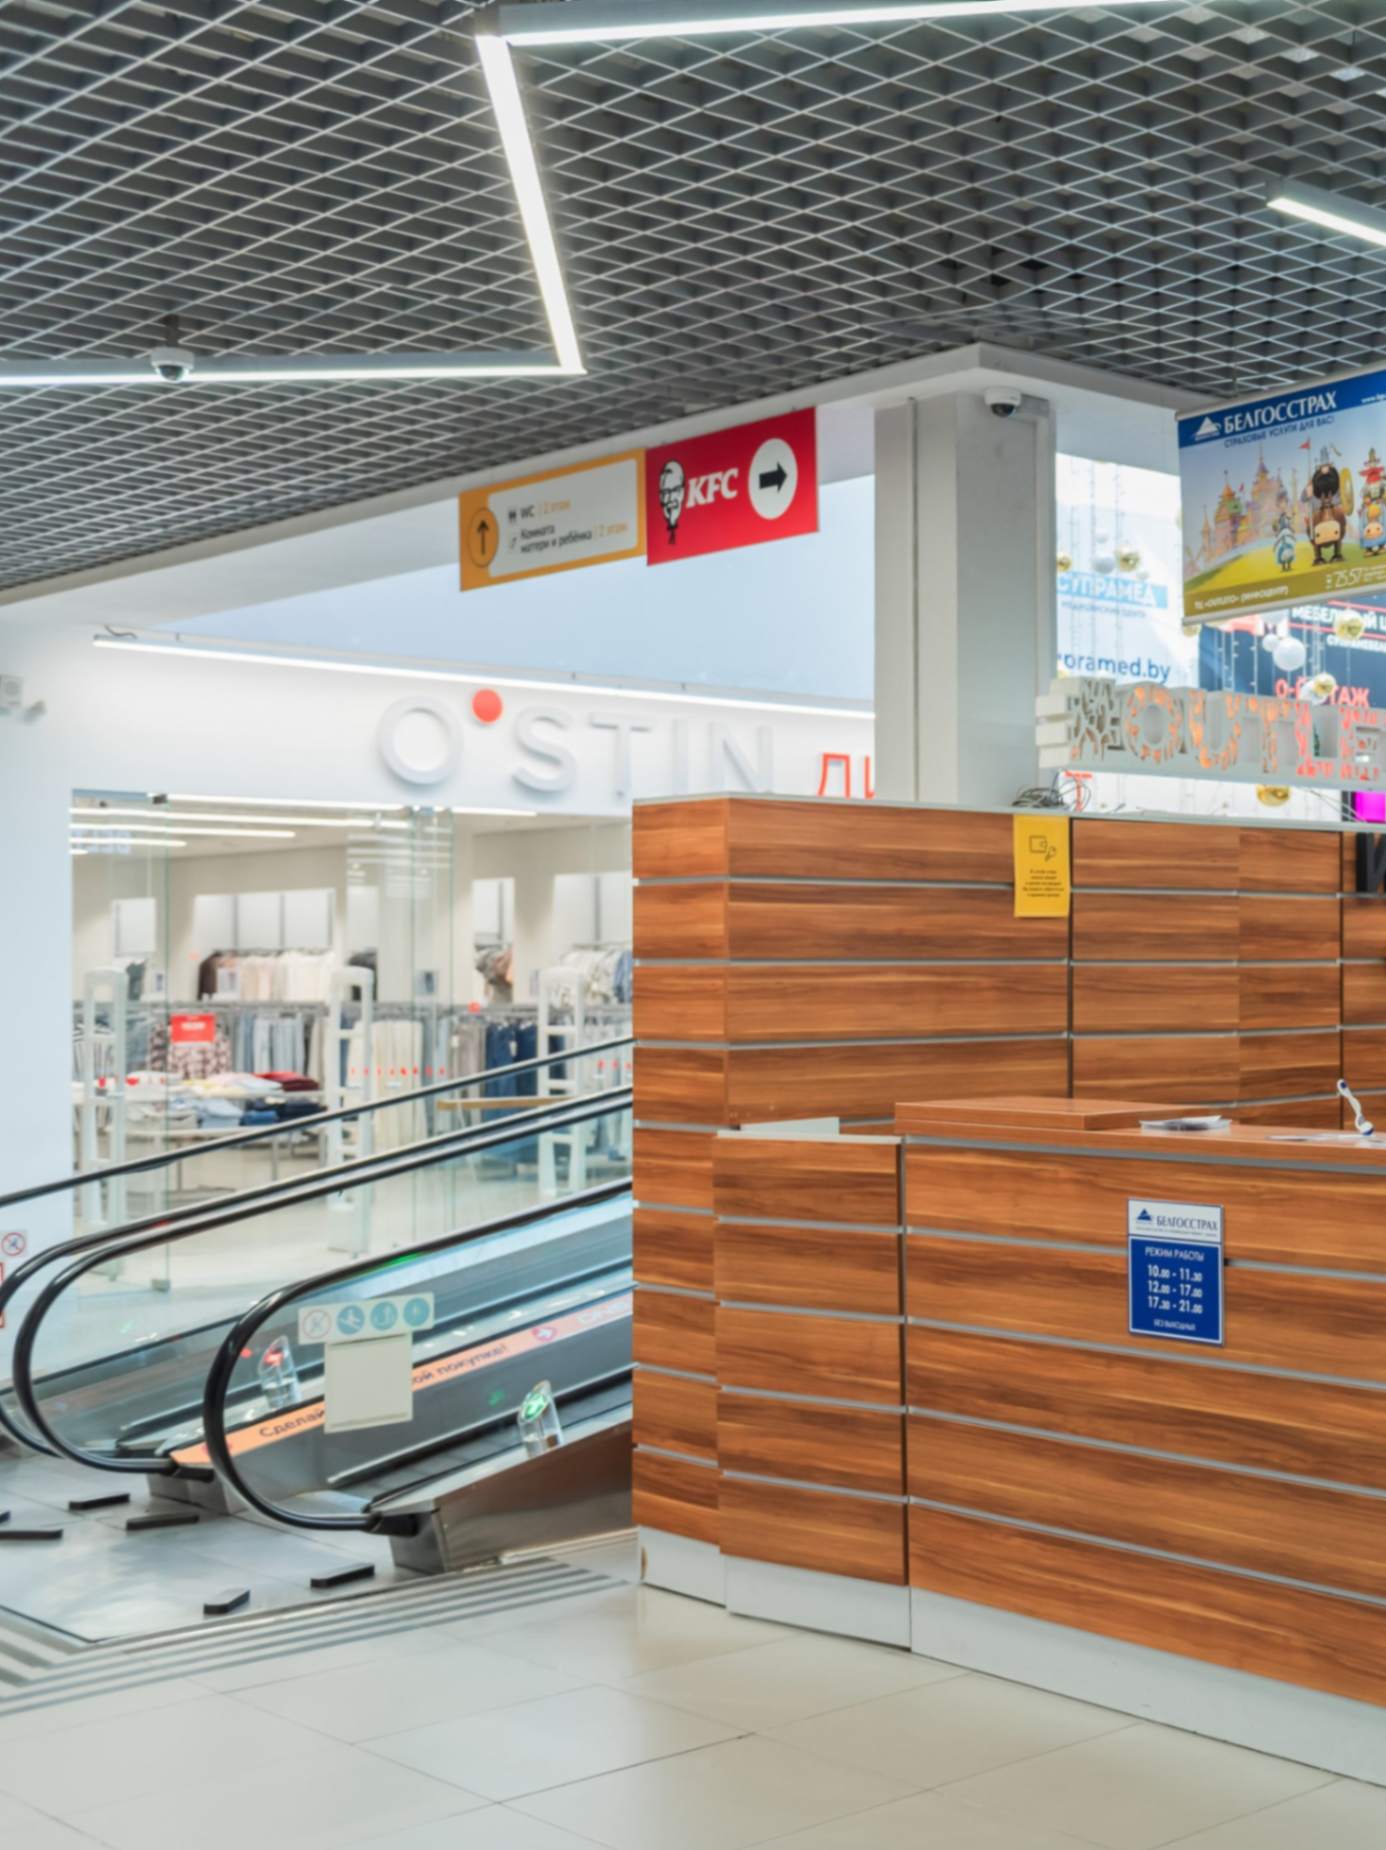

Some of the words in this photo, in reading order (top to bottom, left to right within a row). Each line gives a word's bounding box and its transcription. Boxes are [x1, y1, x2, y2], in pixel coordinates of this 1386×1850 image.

[1223, 391, 1337, 435] БЕЛГОССТРАХ
[686, 468, 739, 508] KFC
[1292, 606, 1377, 629] МЕБЕЛЙ
[1156, 1215, 1218, 1231] БЕЛГОССТРАХ
[1145, 1246, 1172, 1260] РЕЖИМ
[1174, 1250, 1204, 1262] РАБОТЫ
